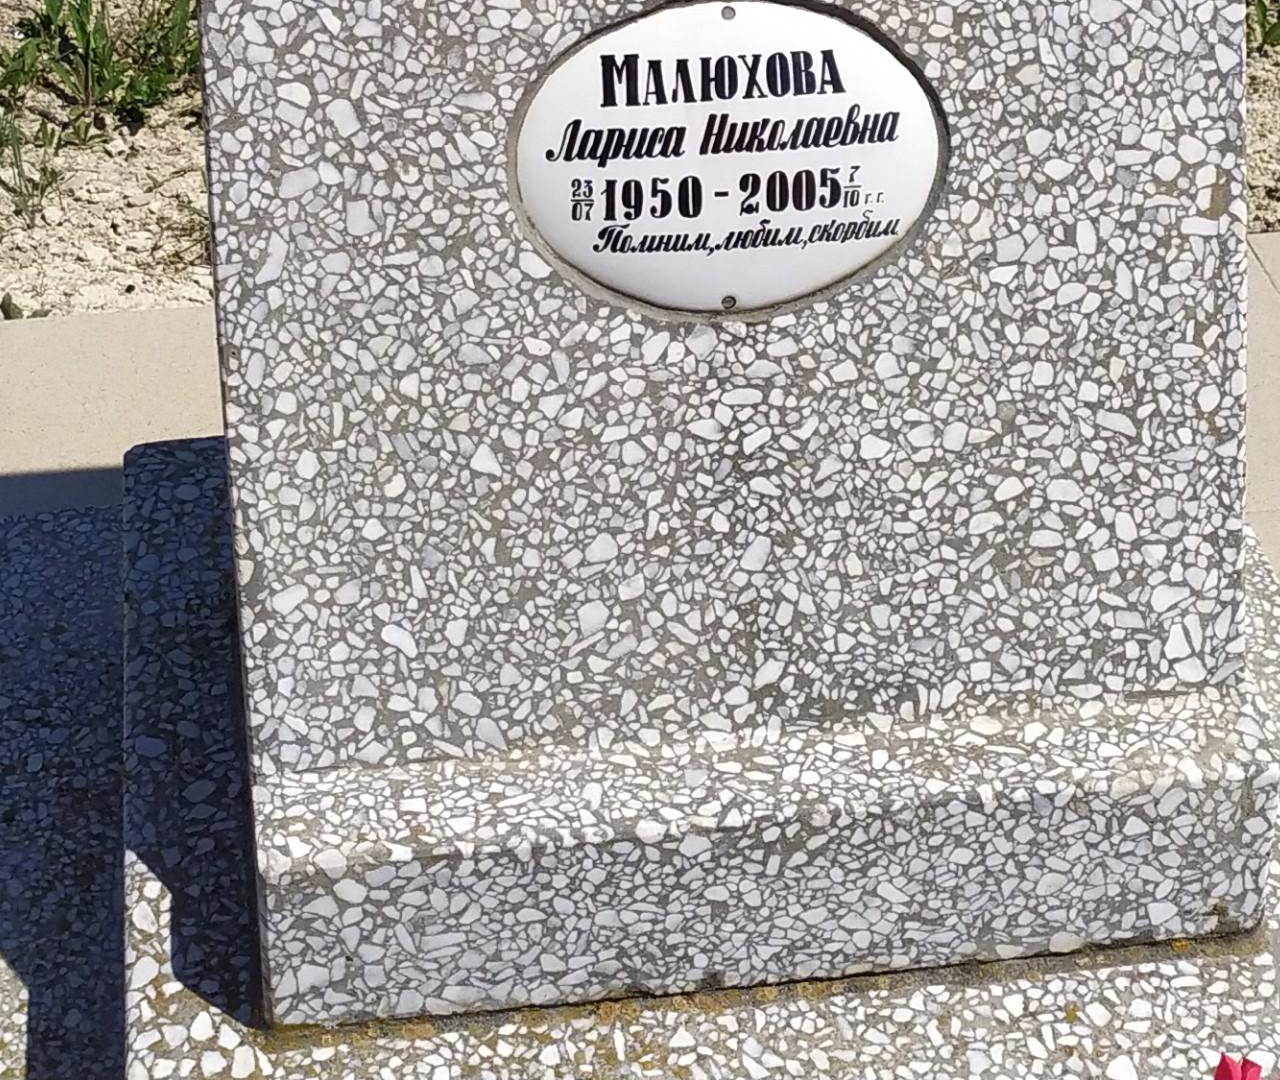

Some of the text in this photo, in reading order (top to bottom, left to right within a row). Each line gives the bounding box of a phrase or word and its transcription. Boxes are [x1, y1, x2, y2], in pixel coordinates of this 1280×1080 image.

[599, 49, 846, 108] МАЛЮХОВА
[545, 103, 900, 168] Лариса Николаевна
[570, 178, 594, 199] 23
[570, 202, 595, 222] 07
[600, 175, 703, 222] 1950
[738, 167, 842, 217] 2005
